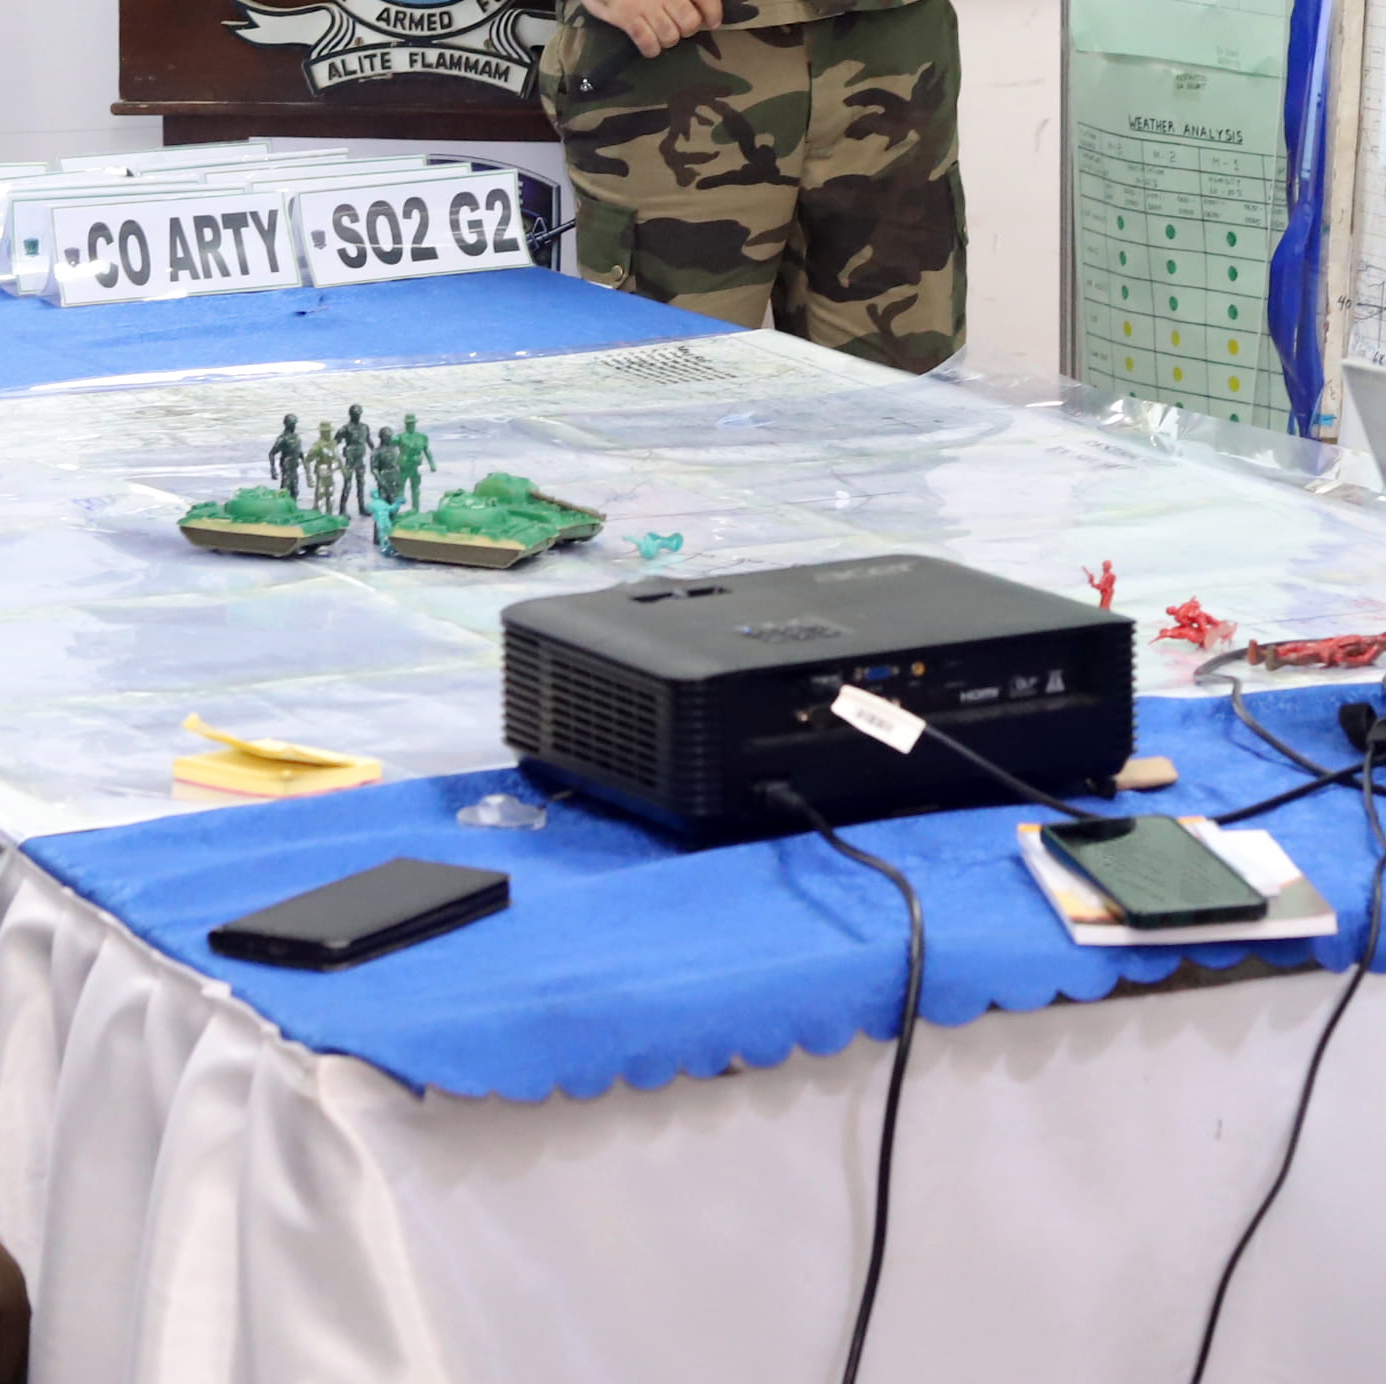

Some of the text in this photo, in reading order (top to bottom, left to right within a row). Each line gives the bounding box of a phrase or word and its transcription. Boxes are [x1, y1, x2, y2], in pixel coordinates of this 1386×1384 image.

[376, 7, 453, 32] ARMED
[328, 52, 509, 83] ALITE FLAMMAM
[1128, 115, 1243, 144] WEATHER ANALYSIS
[332, 188, 520, 269] SO2 G2
[87, 208, 281, 288] CO ARTY
[960, 687, 999, 702] HDMI
